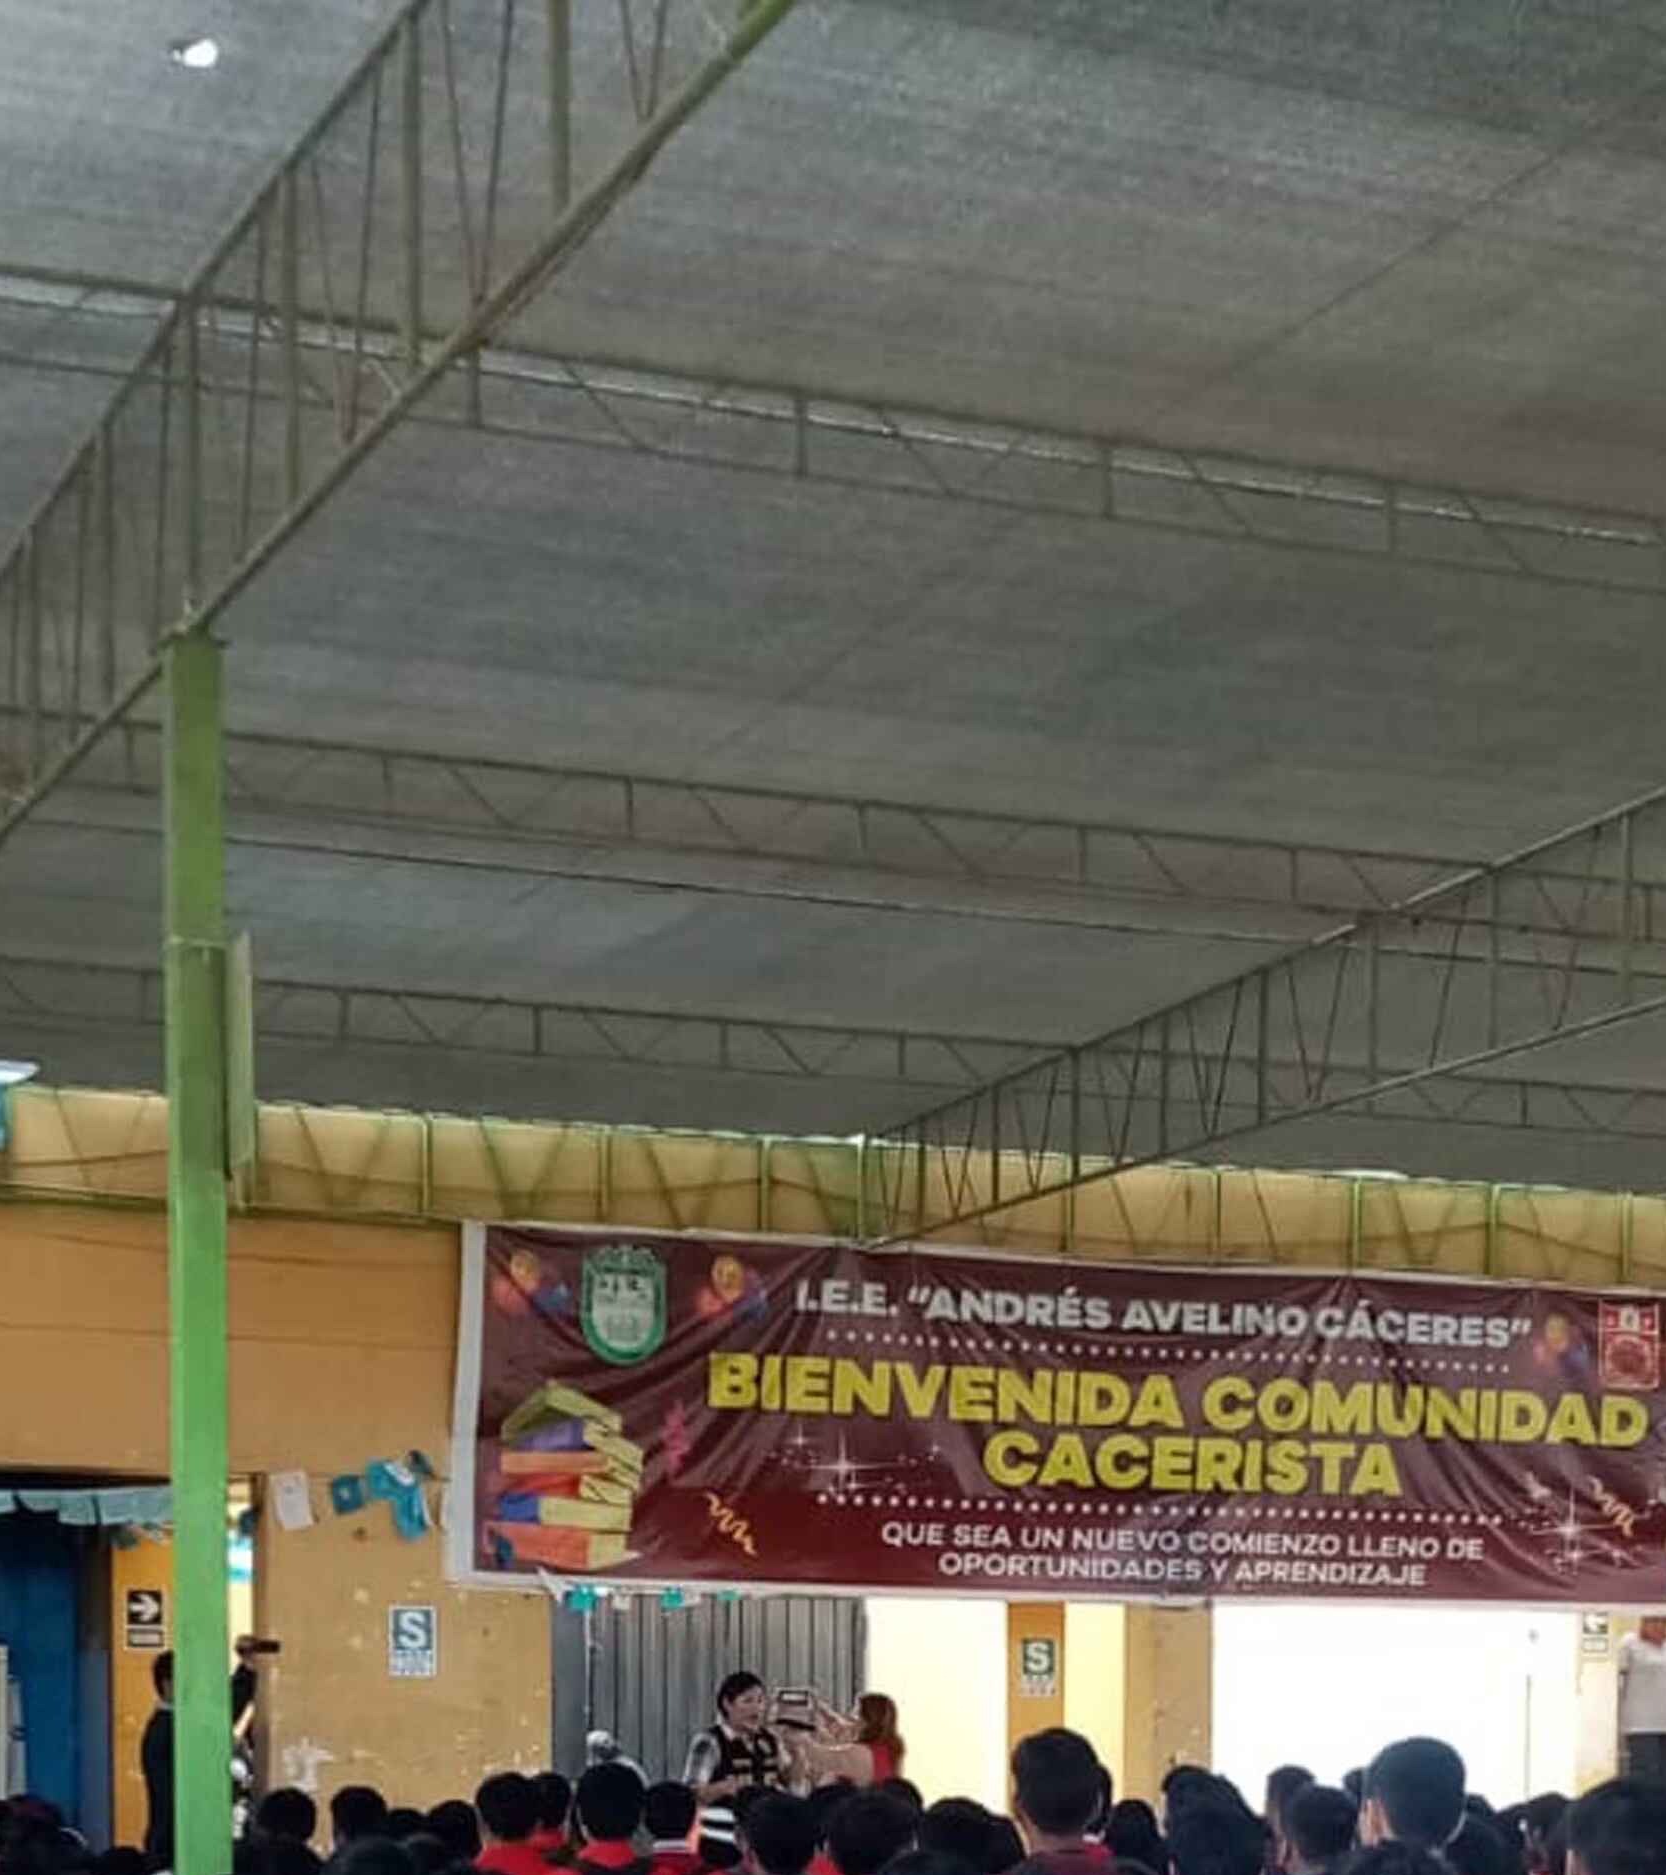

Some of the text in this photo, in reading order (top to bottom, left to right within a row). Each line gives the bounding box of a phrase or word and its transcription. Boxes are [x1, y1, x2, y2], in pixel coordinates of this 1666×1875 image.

[796, 1279, 899, 1318] I.E.E.
[1120, 1299, 1310, 1338] AVELINO
[707, 1351, 1650, 1448] BIENVENIDA COMUNIDAD
[983, 1430, 1403, 1497] CACERISTA
[882, 1520, 1485, 1561] QUE SEA UN NUEVO COMIENZO LLENO DE
[937, 1551, 1428, 1586] OPORTUNIDADES Y APRENDIZAJE
[398, 1611, 427, 1649] S
[1026, 1642, 1050, 1672] S
